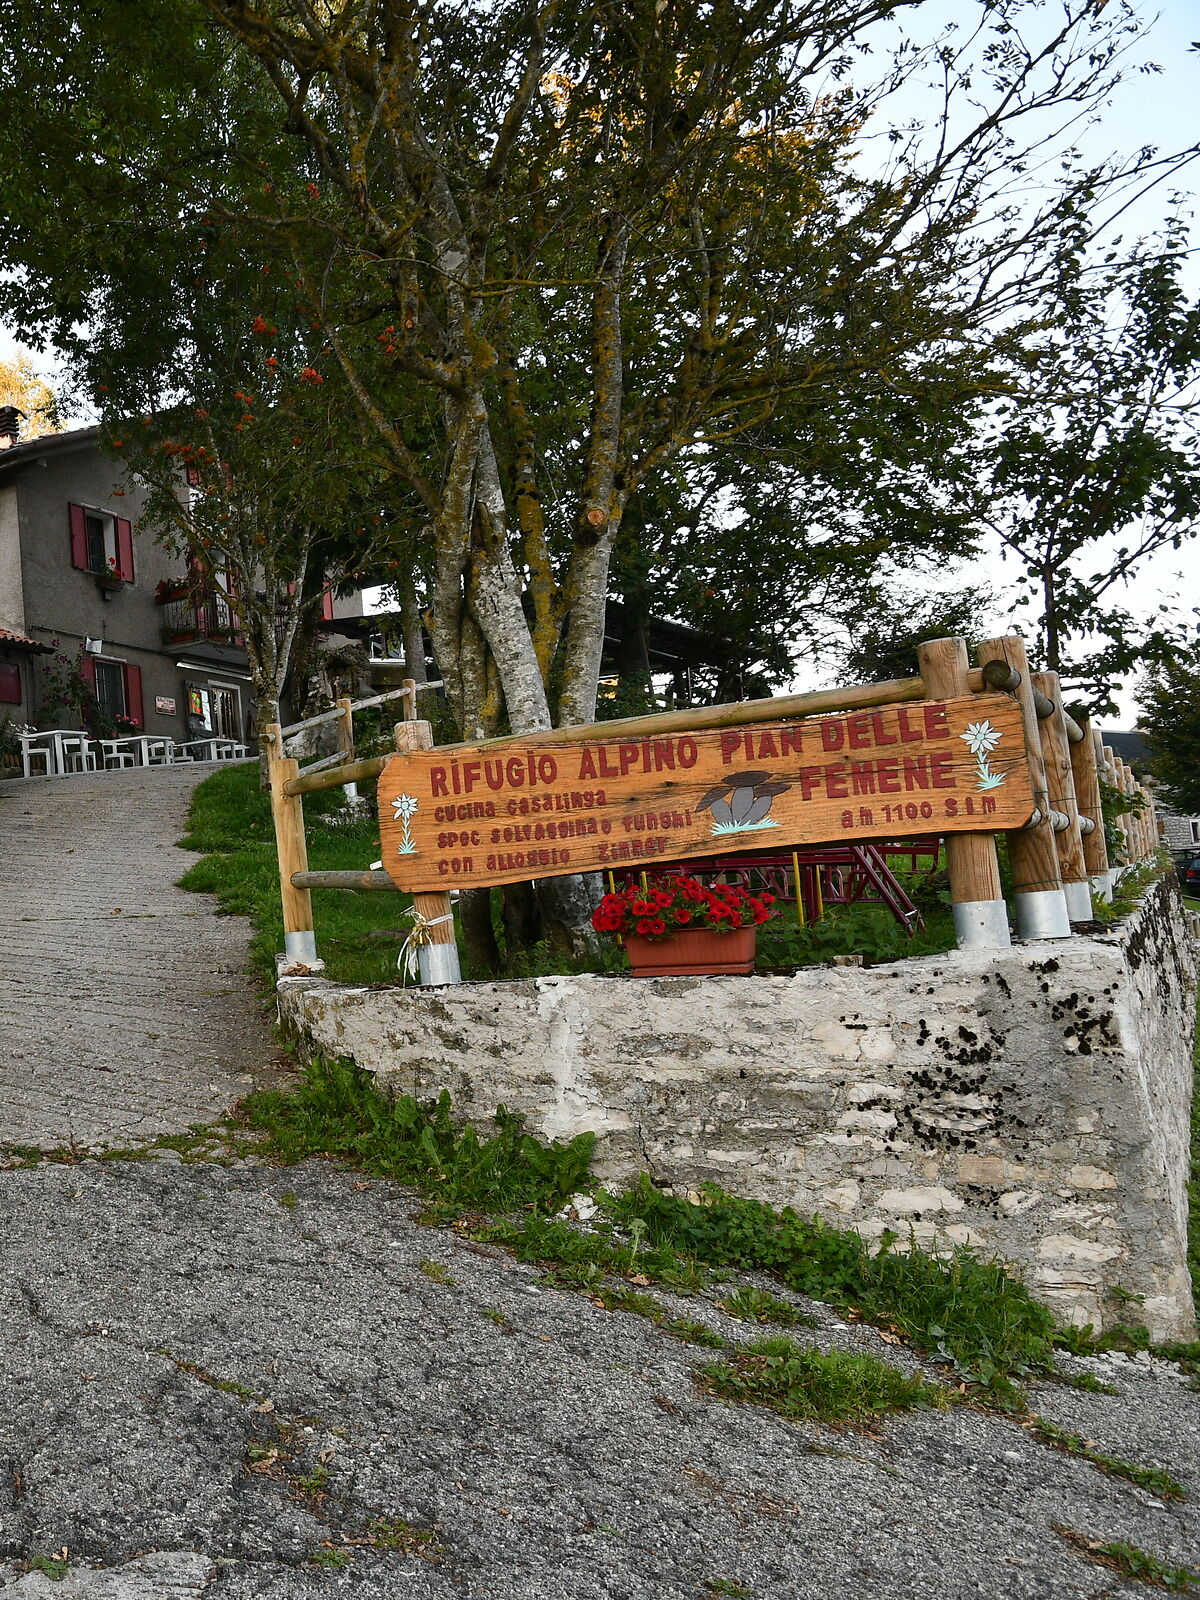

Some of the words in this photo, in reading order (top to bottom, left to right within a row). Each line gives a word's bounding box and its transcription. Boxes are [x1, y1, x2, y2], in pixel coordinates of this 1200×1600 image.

[430, 751, 558, 797] RIFUGIO
[579, 736, 698, 781] ALPINO
[720, 726, 803, 764] PIAN
[820, 705, 951, 751] DELLE
[800, 752, 956, 801] FEMENE
[438, 856, 473, 875] con
